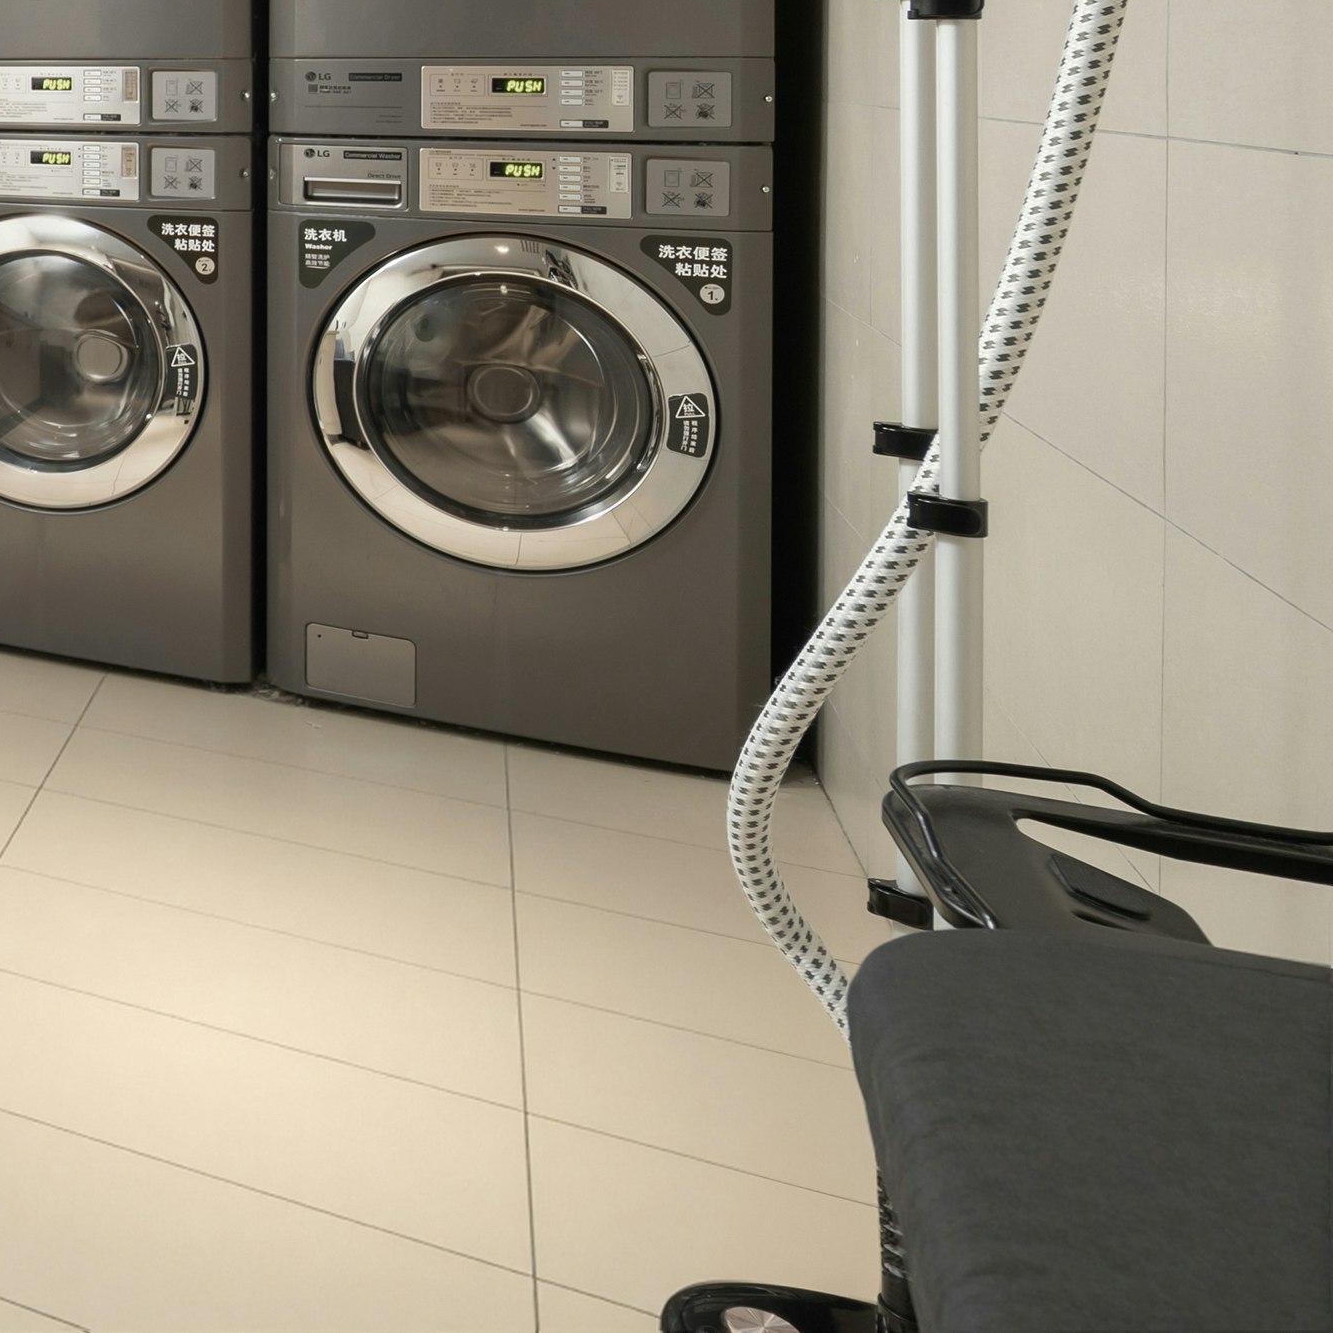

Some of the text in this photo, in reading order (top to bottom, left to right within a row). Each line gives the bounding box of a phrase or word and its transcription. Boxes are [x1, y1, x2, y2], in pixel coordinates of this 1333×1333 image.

[42, 78, 71, 90] PUSH
[506, 79, 542, 93] PUSH
[42, 152, 70, 164] PUSH
[505, 163, 541, 177] PUSH
[161, 222, 215, 237] 洗衣便签
[304, 228, 348, 242] 洗衣机
[174, 238, 215, 252] 粘贴处
[658, 244, 728, 262] 洗衣便签
[201, 263, 208, 272] 2
[675, 262, 727, 279] 粘贴处
[707, 290, 714, 300] 1
[683, 403, 695, 412] 拉
